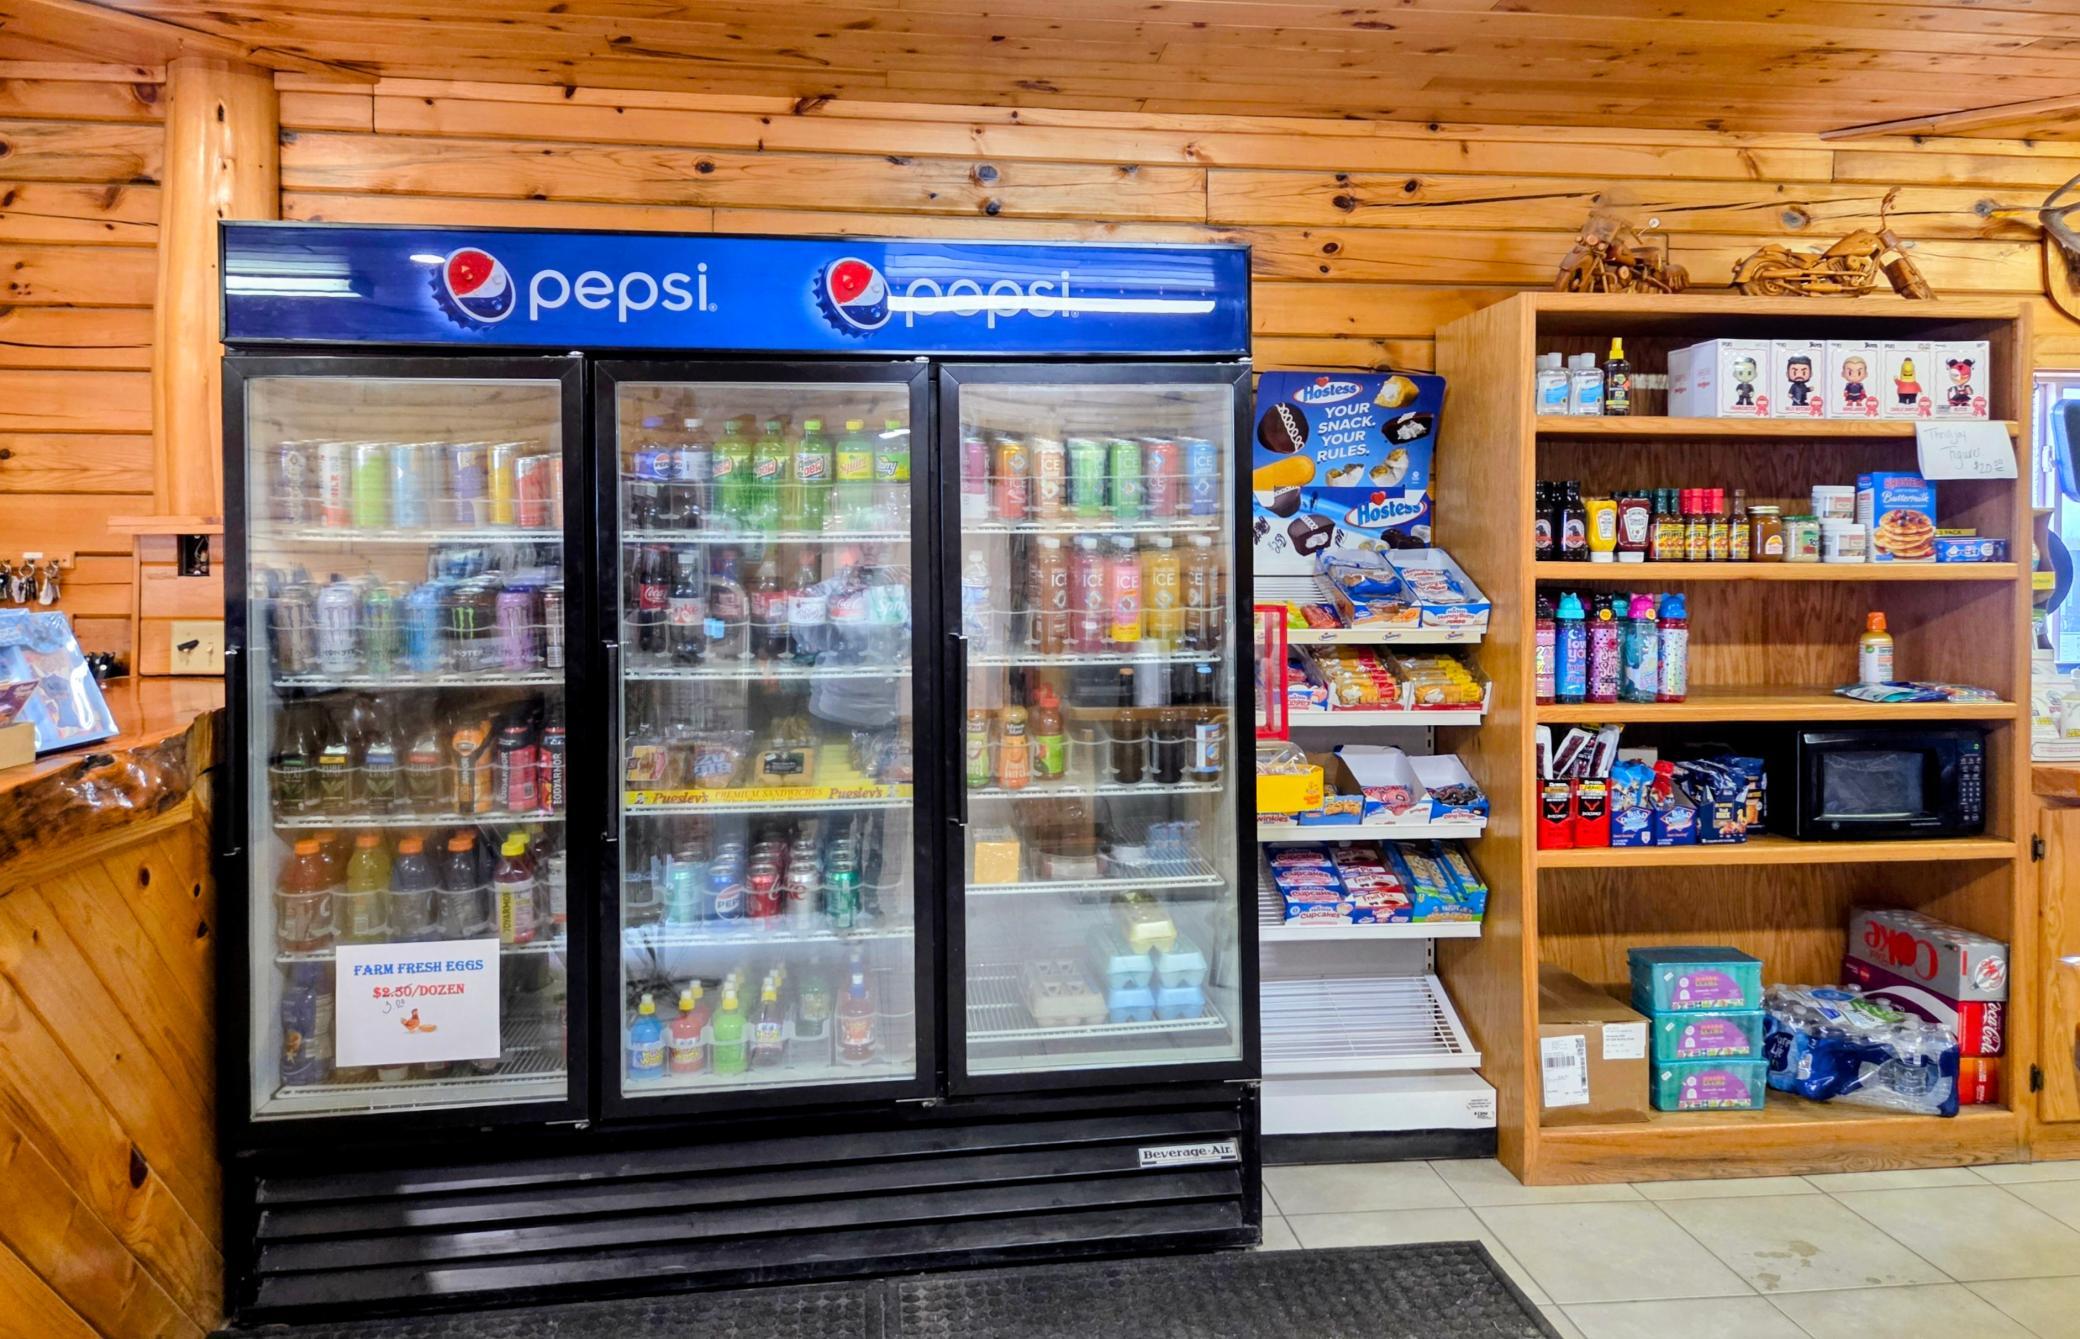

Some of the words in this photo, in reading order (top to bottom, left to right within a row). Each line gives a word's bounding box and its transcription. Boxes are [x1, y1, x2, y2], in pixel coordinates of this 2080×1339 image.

[529, 262, 707, 322] pepsi
[1303, 382, 1357, 402] Hostess
[1324, 403, 1370, 418] YOUR
[1317, 416, 1376, 434] SNACK.
[1321, 431, 1365, 447] YOUR
[1316, 445, 1370, 462] RULES.
[1357, 501, 1421, 526] Hostess
[1116, 575, 1139, 589] ICE
[1152, 572, 1177, 586] ICE
[1257, 815, 1288, 823] winkies
[353, 964, 394, 976] FARM
[397, 961, 442, 975] FRESH
[446, 959, 484, 971] EGGS
